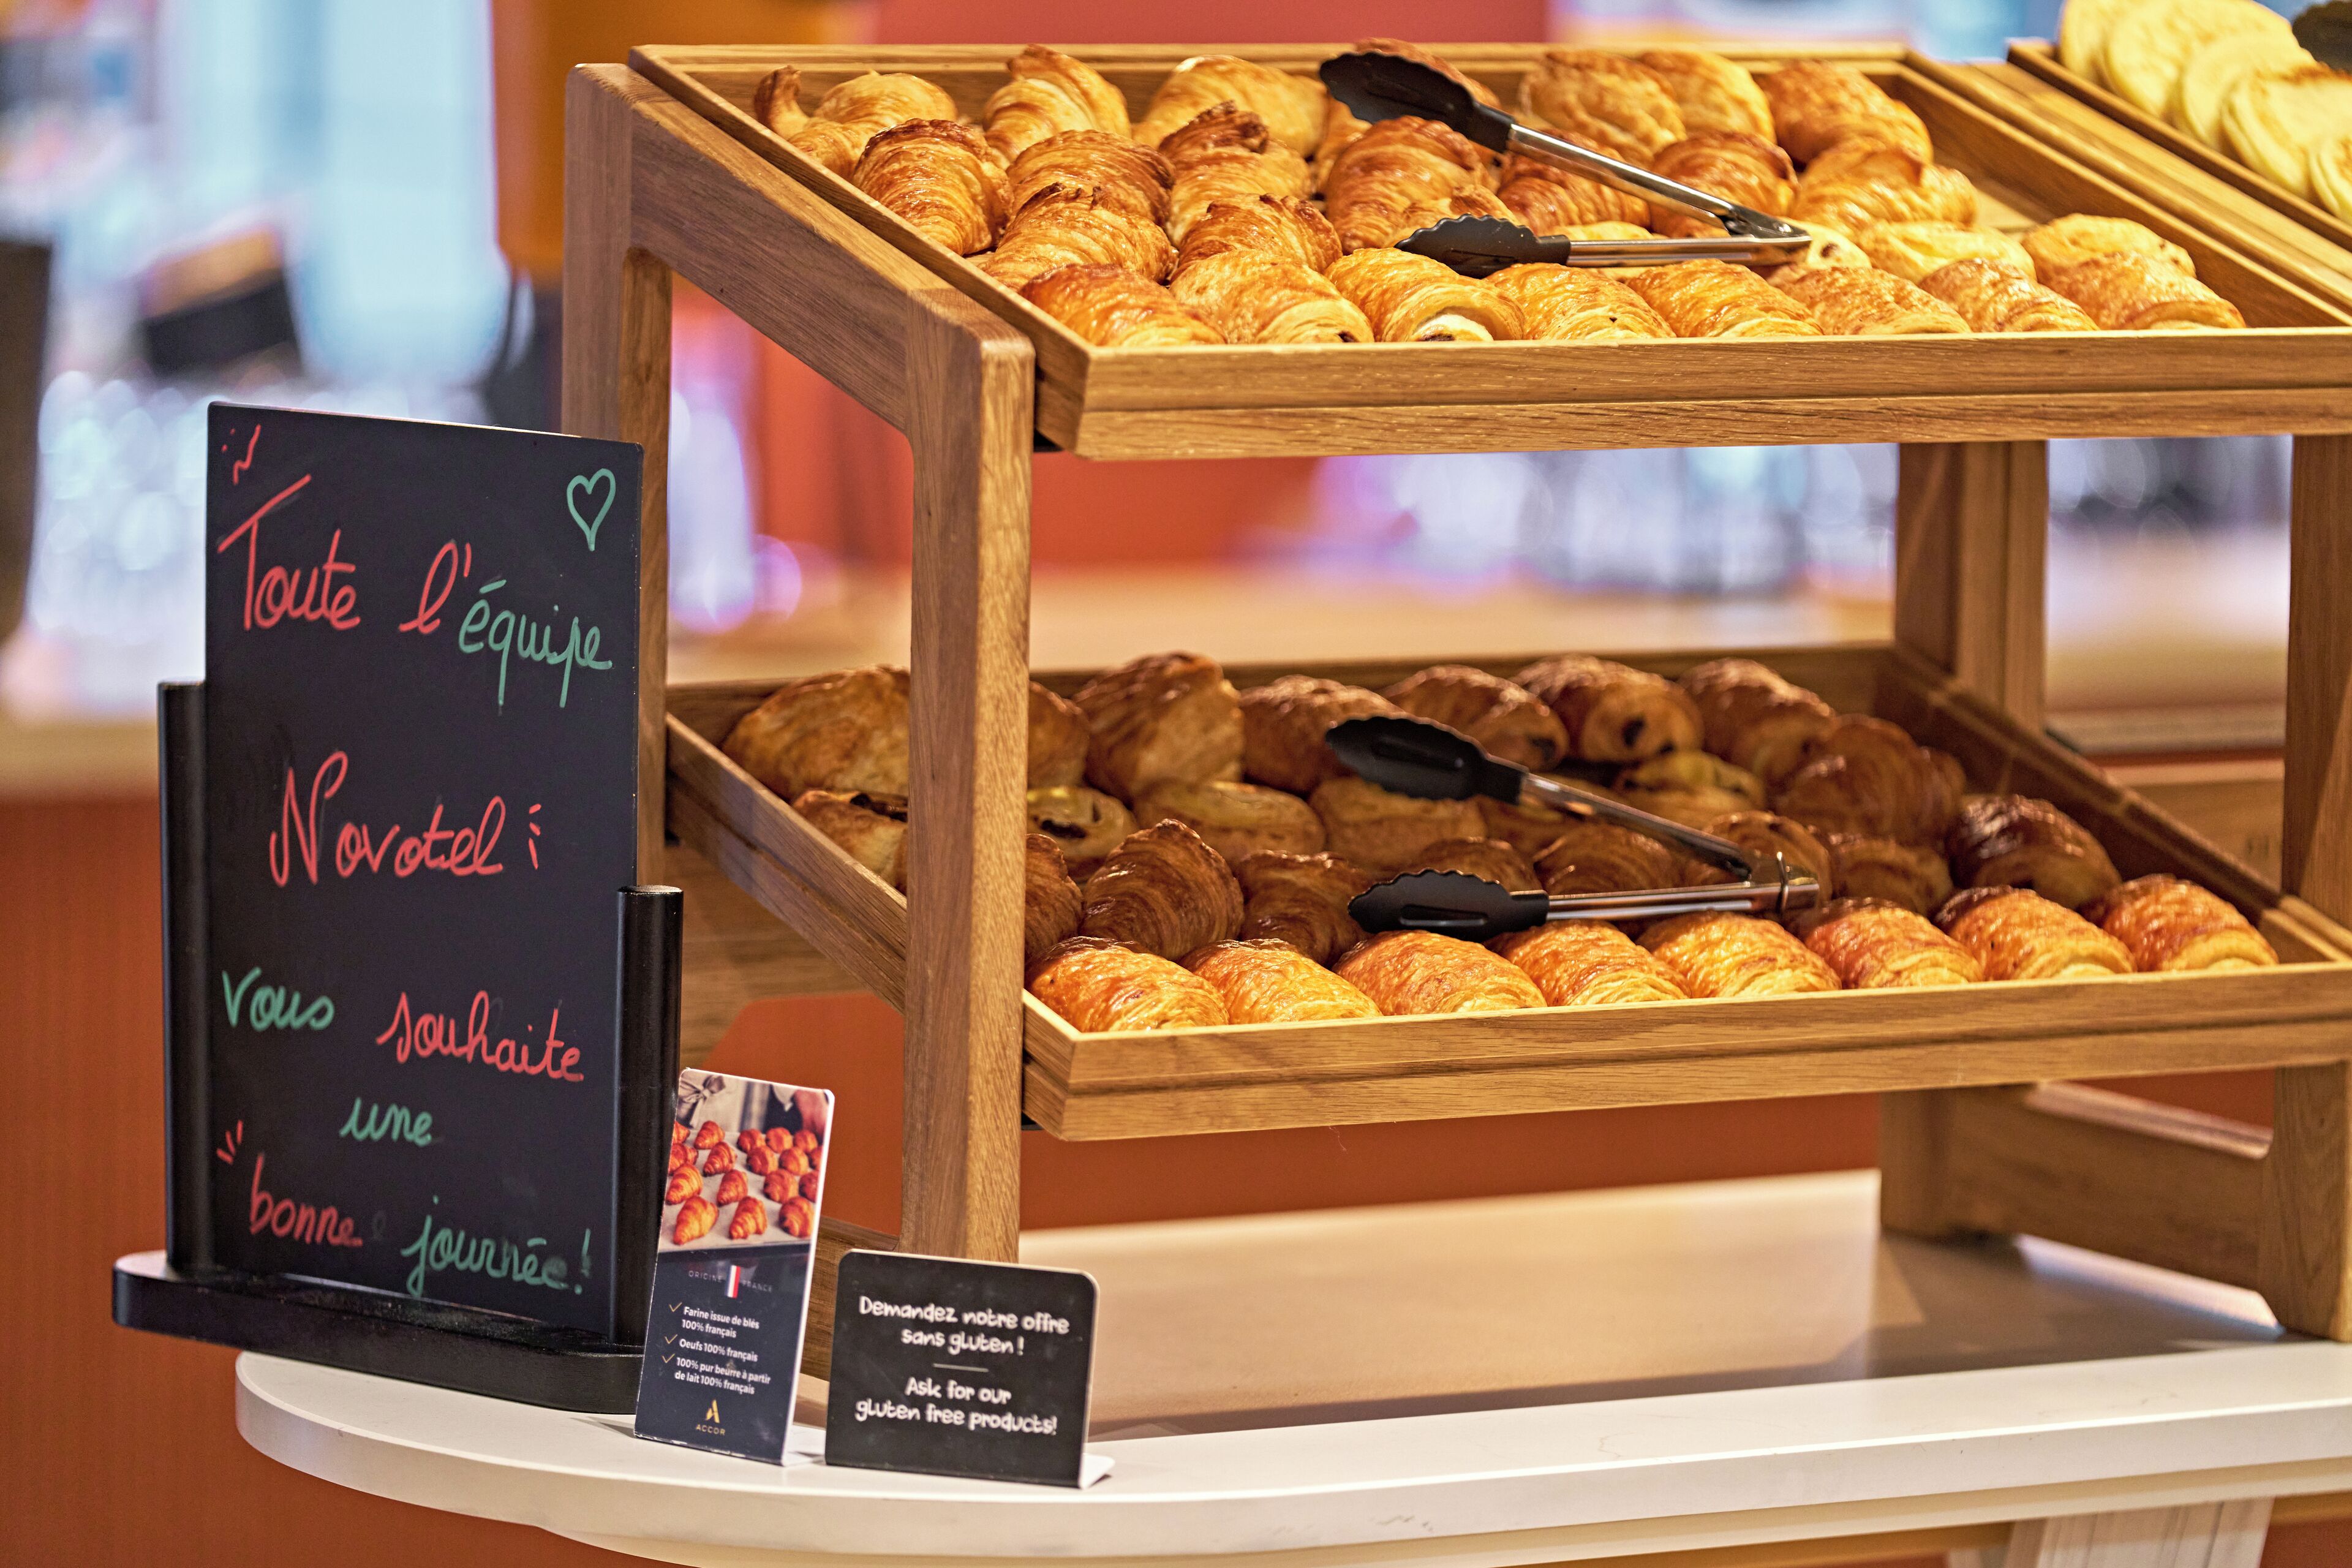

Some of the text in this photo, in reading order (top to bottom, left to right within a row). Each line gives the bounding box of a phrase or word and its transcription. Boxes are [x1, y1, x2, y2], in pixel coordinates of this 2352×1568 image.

[217, 474, 361, 631] Toute
[270, 750, 505, 887] Novotel
[376, 990, 584, 1082] souhaite
[339, 1097, 432, 1147] une
[250, 1153, 363, 1247] bonne
[682, 1319, 736, 1338] 100% français
[684, 1306, 760, 1329] Farine issue de blés
[859, 1296, 1070, 1334] Demandez notre offre
[679, 1338, 758, 1362] Oeufs 100% français
[901, 1329, 946, 1347] sans
[675, 1371, 755, 1395] de lait 100% français
[677, 1357, 771, 1385] 100% pur beurre à partir
[905, 1377, 1012, 1404] Ask for our
[696, 1424, 726, 1436] ACCOR
[855, 1398, 1058, 1436] gluten free products!
